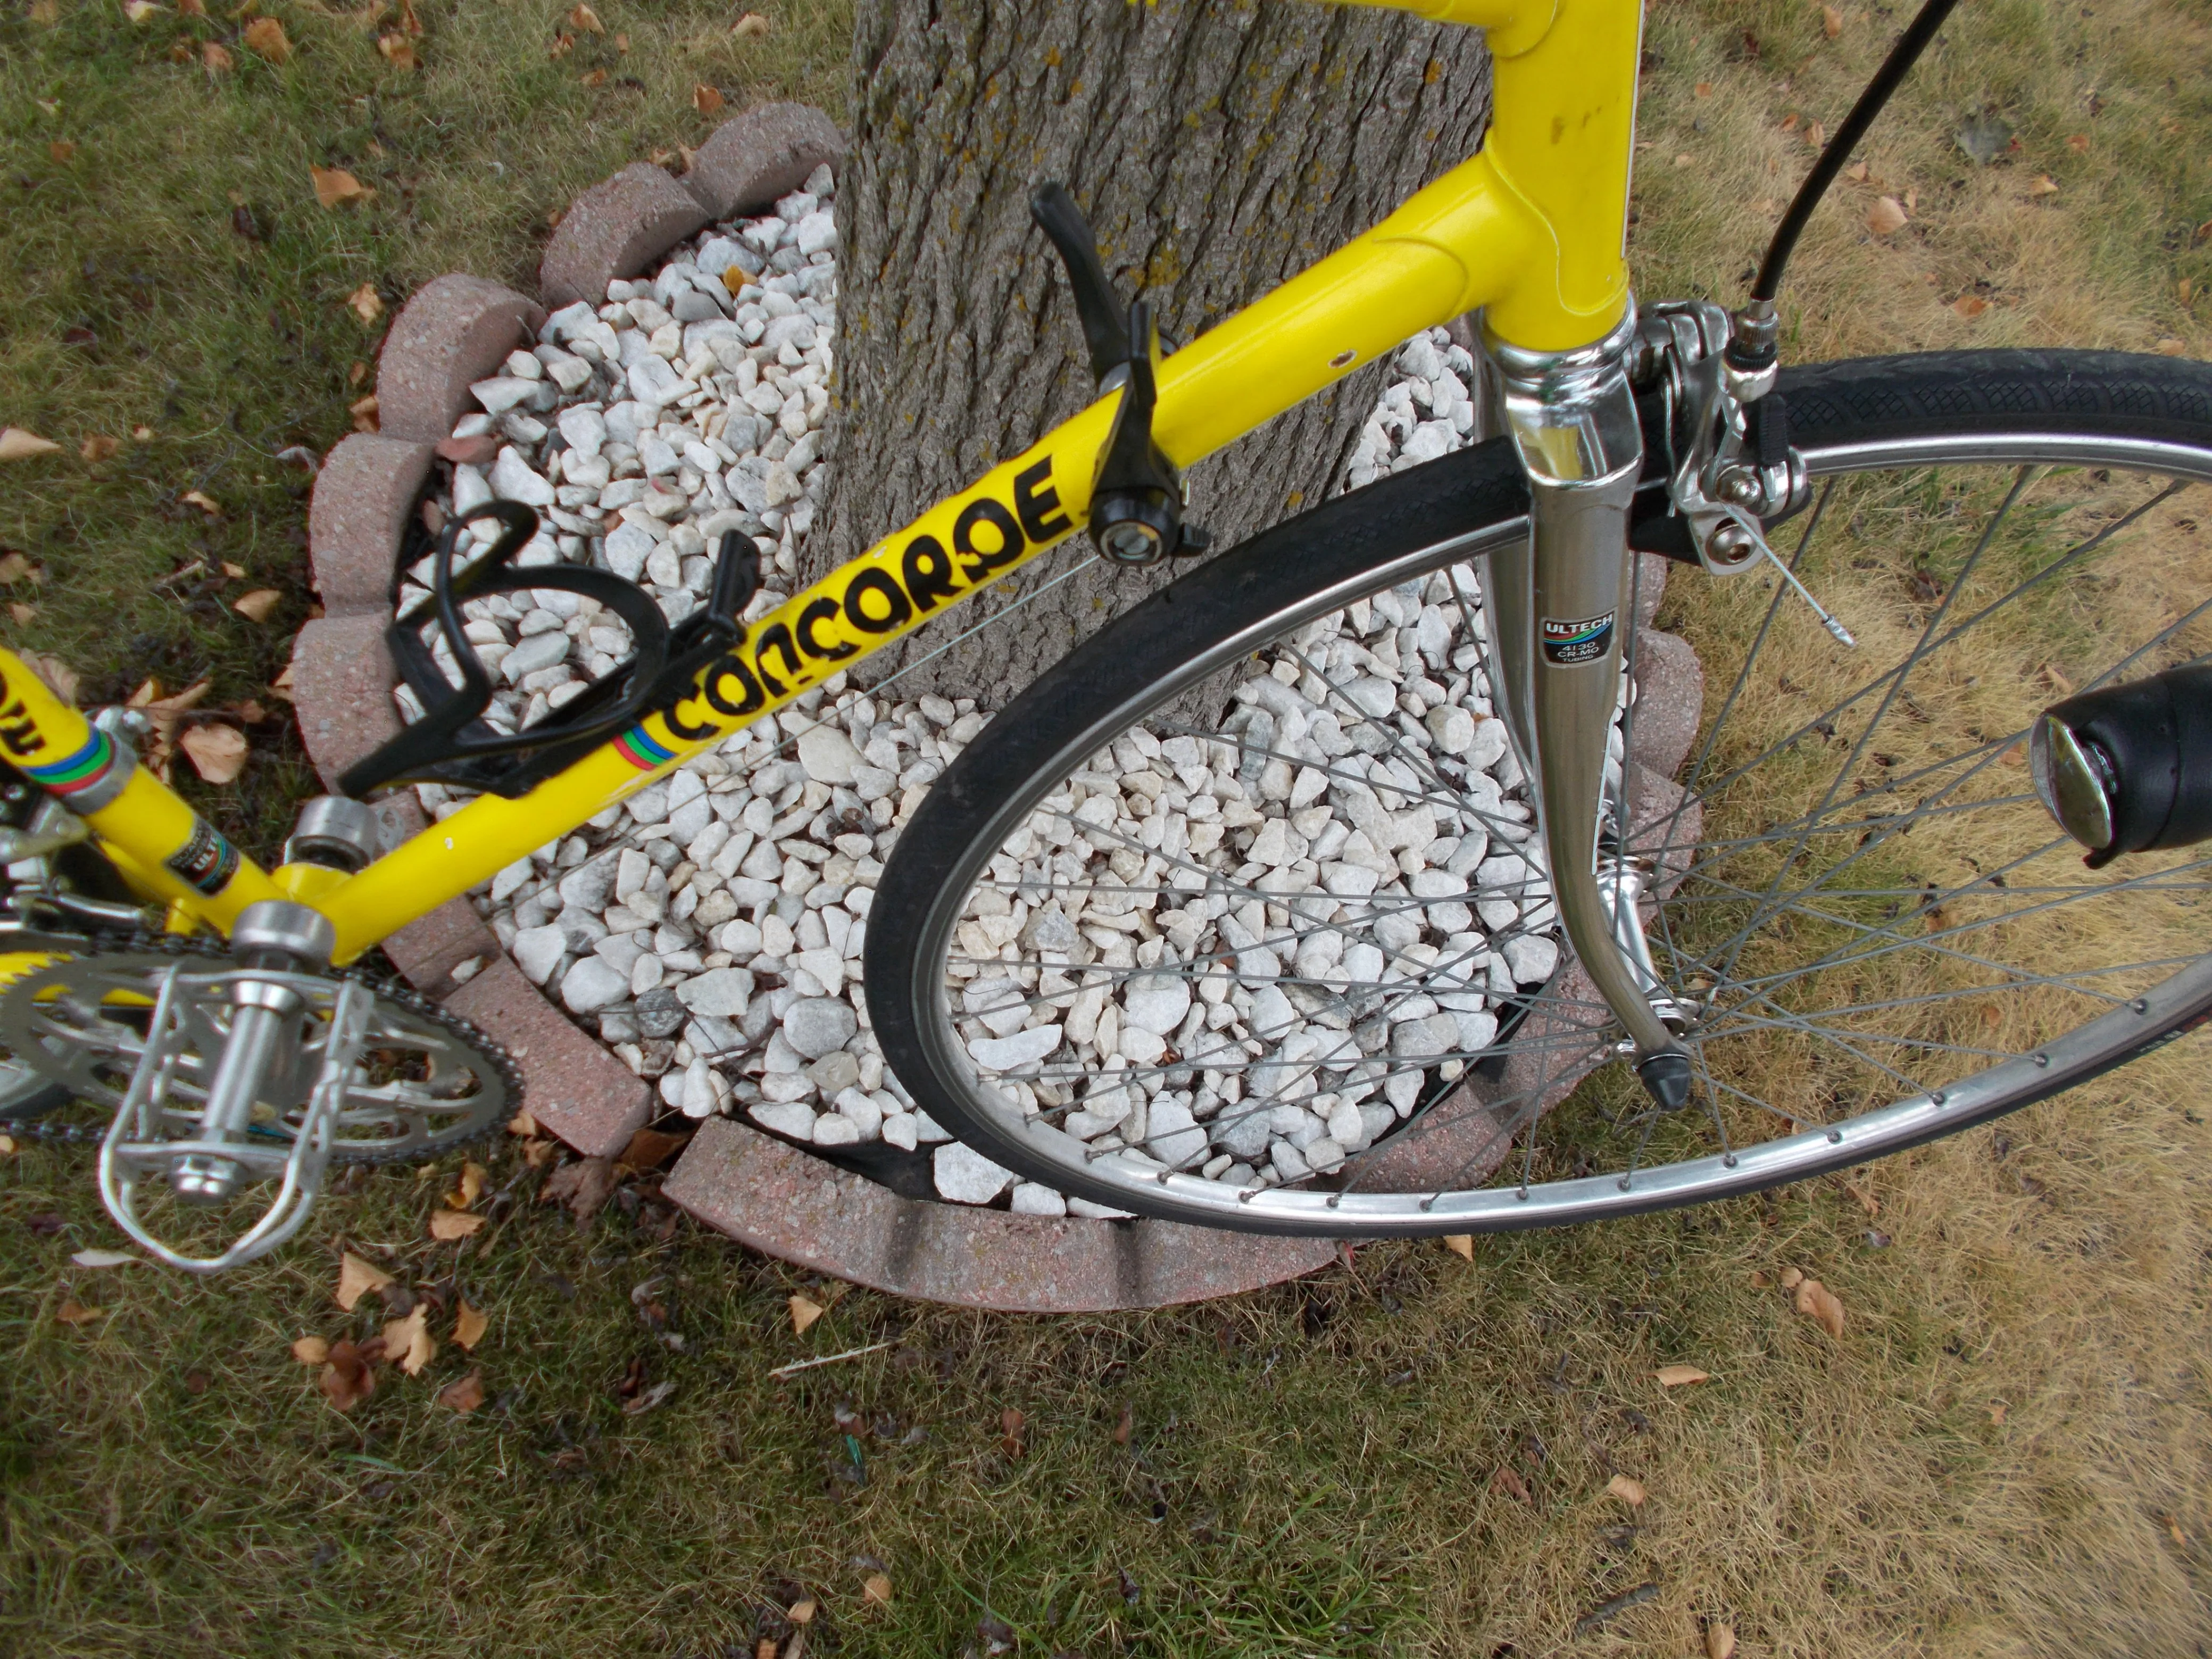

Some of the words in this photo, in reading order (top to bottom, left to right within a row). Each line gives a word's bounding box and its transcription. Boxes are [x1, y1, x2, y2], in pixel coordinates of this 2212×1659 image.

[1546, 613, 1612, 634] ULTECH
[1557, 646, 1599, 658] CR-MO
[1562, 642, 1595, 651] 4130
